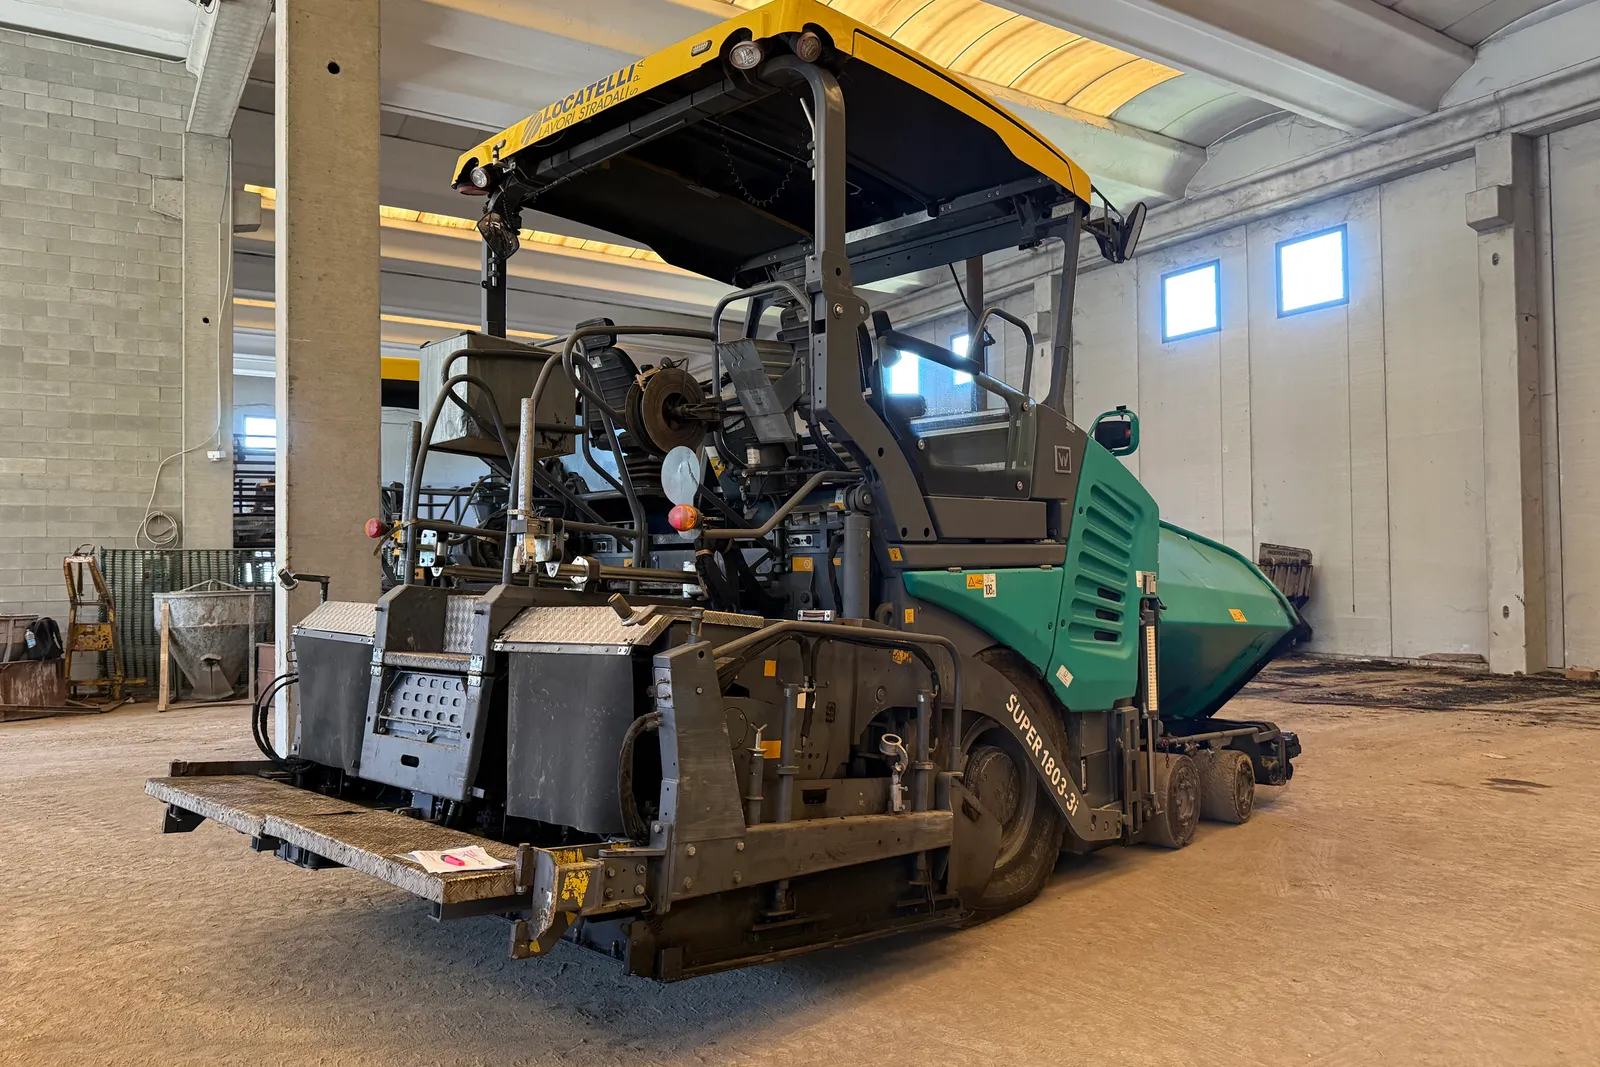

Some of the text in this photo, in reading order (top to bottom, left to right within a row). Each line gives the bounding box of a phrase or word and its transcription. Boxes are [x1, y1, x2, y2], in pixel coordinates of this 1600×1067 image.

[538, 85, 630, 139] LAVORI STRADALI
[542, 63, 635, 123] LOCATELLI
[1005, 694, 1079, 816] SUPER 1803-3i
